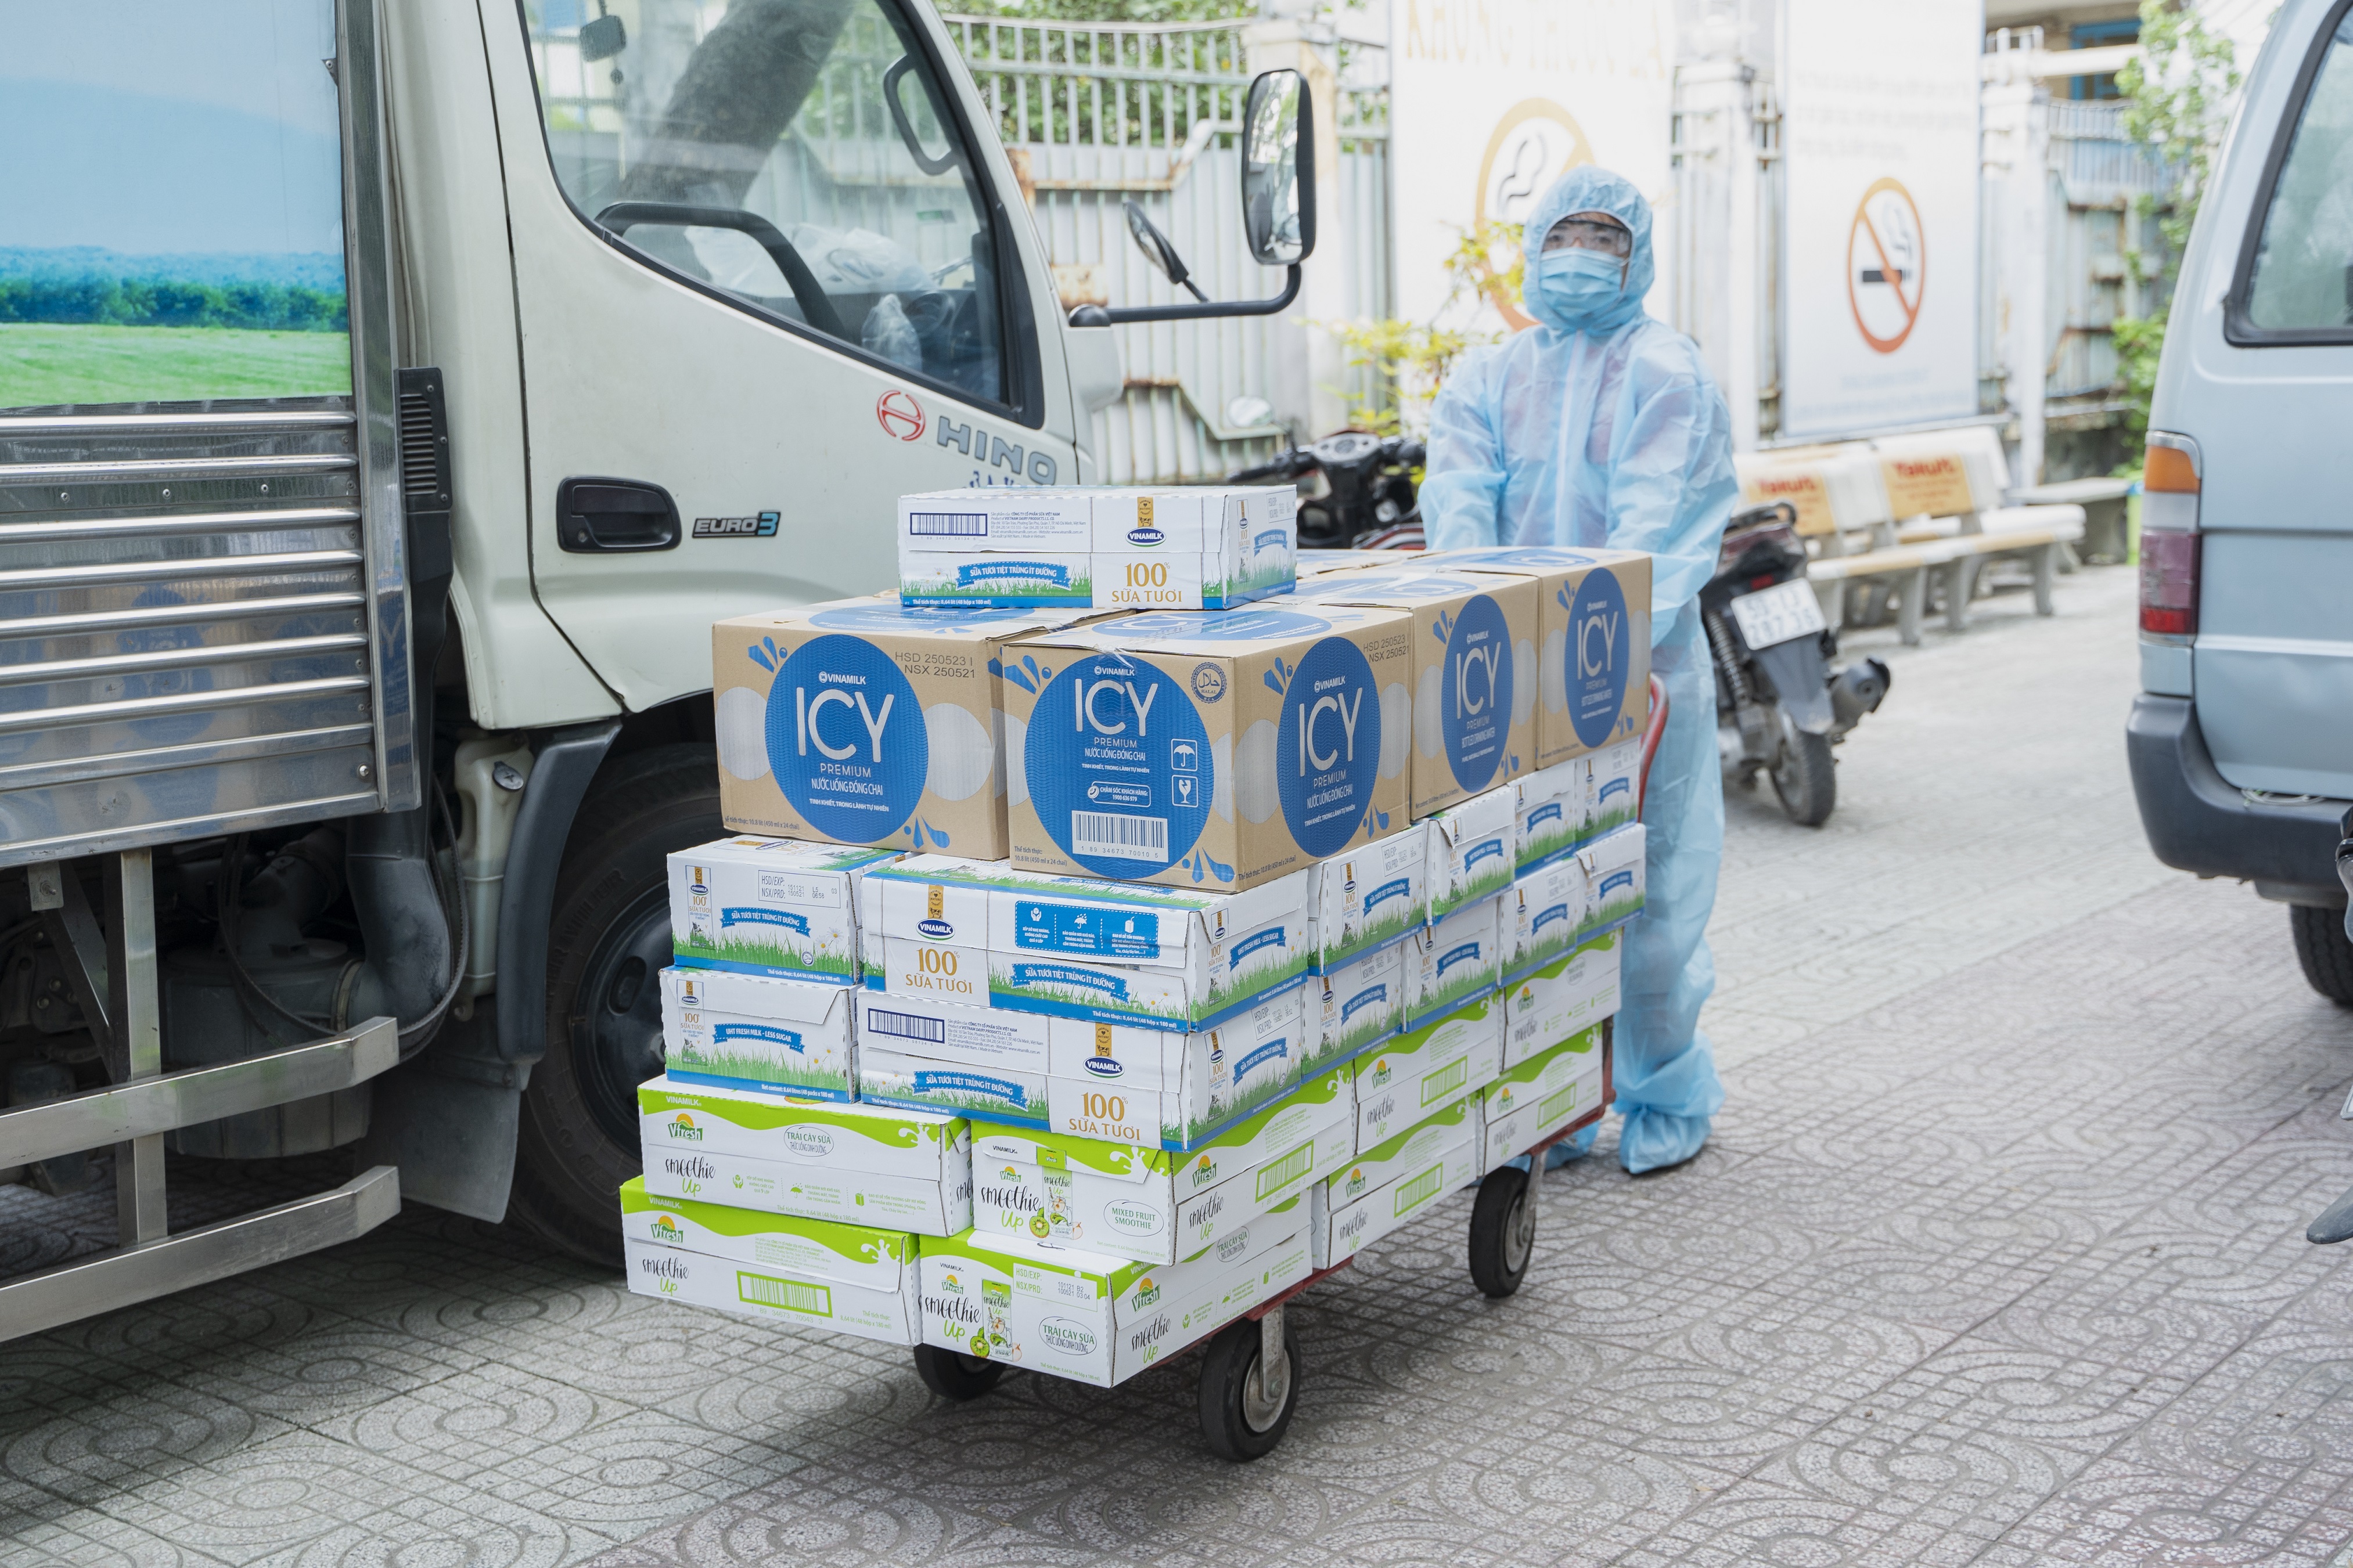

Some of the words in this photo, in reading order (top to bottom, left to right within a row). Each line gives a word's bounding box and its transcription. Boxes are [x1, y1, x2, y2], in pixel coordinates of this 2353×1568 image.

[937, 416, 1057, 486] HINO
[970, 567, 981, 576] SỮA
[982, 567, 996, 575] TƯƠI
[996, 565, 1008, 575] TIỆT
[1009, 565, 1030, 574] TRÙNG
[1029, 565, 1034, 574] ÍT
[1035, 567, 1057, 577] ĐƯỜNG
[1111, 588, 1141, 602] SỮA
[1144, 589, 1182, 602] TƯƠI
[1363, 641, 1379, 653] HSD
[1381, 635, 1405, 648] 250523
[1577, 611, 1618, 680] ICY
[895, 652, 920, 662] HSD
[925, 654, 966, 666] 250523
[1369, 653, 1384, 663] NSX
[1386, 646, 1409, 659] 250521
[827, 675, 866, 685] VINAMILK
[905, 665, 930, 675] NSX
[934, 666, 975, 678] 250521
[1456, 641, 1501, 719] ICY
[1320, 676, 1345, 690] VINAMILK
[1075, 679, 1158, 736] ICY
[796, 687, 894, 763] ICY
[1299, 687, 1362, 777] ICY
[1466, 715, 1490, 730] PREMIUM
[1094, 737, 1136, 748] PREMIUM
[1085, 747, 1100, 757] NƯỚC
[1100, 747, 1116, 759] UỐNG
[1117, 749, 1132, 760] ĐÓNG
[1133, 752, 1146, 760] CHAI
[820, 763, 871, 777] PREMIUM
[1314, 769, 1346, 789] PREMIUM
[811, 777, 829, 790] NƯỚC
[830, 778, 848, 792] UỐNG
[848, 780, 867, 794] ĐÓNG
[868, 784, 883, 795] CHAI
[821, 799, 836, 807] KHIẾT,
[1307, 794, 1319, 809] NƯỚC
[1319, 789, 1331, 805] UỐNG
[1331, 786, 1343, 801] ĐÓNG
[1344, 784, 1352, 797] CHAI
[761, 875, 785, 886] HSD/EXP:
[731, 911, 740, 919] SỮA
[752, 910, 761, 920] TIỆT
[761, 911, 778, 921] TRÙNG
[778, 914, 782, 922] ÍT
[782, 917, 800, 926] ĐƯỜNG
[920, 923, 952, 933] VINAMILK
[905, 972, 933, 989] SỮA
[936, 978, 973, 994] TƯƠI
[1025, 967, 1037, 977] SỮA
[1037, 969, 1052, 977] TƯƠI
[1052, 969, 1064, 979] TIỆT
[1065, 971, 1086, 982] TRÙNG
[1086, 975, 1092, 983] ÍT
[1092, 978, 1116, 989] ĐƯỜNG
[776, 1033, 792, 1042] SUGAR
[1087, 1061, 1121, 1072] VINAMILK
[926, 1074, 937, 1084] SỮA
[937, 1076, 951, 1084] TƯƠI
[952, 1076, 963, 1086] TIỆT
[965, 1077, 984, 1088] TRÙNG
[991, 1084, 1013, 1095] ĐƯỜNG
[669, 1123, 701, 1140] Vfresh
[786, 1131, 801, 1141] TRÁI
[803, 1133, 816, 1142] CÂY
[818, 1135, 831, 1144] SỮA
[1069, 1117, 1099, 1134] SỮA
[1102, 1123, 1140, 1141] TƯƠI
[665, 1156, 716, 1179] smoothie
[1000, 1171, 1021, 1182] Vfresh
[1193, 1165, 1217, 1188] Vfresh
[682, 1178, 701, 1197] Up
[981, 1185, 1041, 1212] smoothie
[1111, 1207, 1134, 1217] MIXED
[1136, 1212, 1156, 1221] FRUIT
[1189, 1191, 1224, 1229] smoothie
[1001, 1210, 1024, 1232] Up
[1115, 1217, 1152, 1230] SMOOTHIE
[652, 1225, 683, 1242] Vfresh
[1200, 1221, 1214, 1241] Up
[642, 1257, 690, 1279] smoothie
[660, 1277, 678, 1296] Up
[942, 1281, 964, 1295] Vfresh
[1016, 1268, 1042, 1281] HSD/EXP:
[1058, 1282, 1074, 1290] 101121
[1016, 1281, 1042, 1294] NSX/PRD:
[1058, 1288, 1074, 1296] 100521
[1132, 1286, 1160, 1312] Vfresh
[925, 1297, 981, 1323] smoothie
[944, 1319, 965, 1342] Up
[1043, 1325, 1060, 1337] TRÁI
[1063, 1329, 1078, 1340] CÂY
[1080, 1333, 1095, 1344] SỮA
[1132, 1314, 1171, 1351] smoothie
[1143, 1344, 1158, 1364] Up
